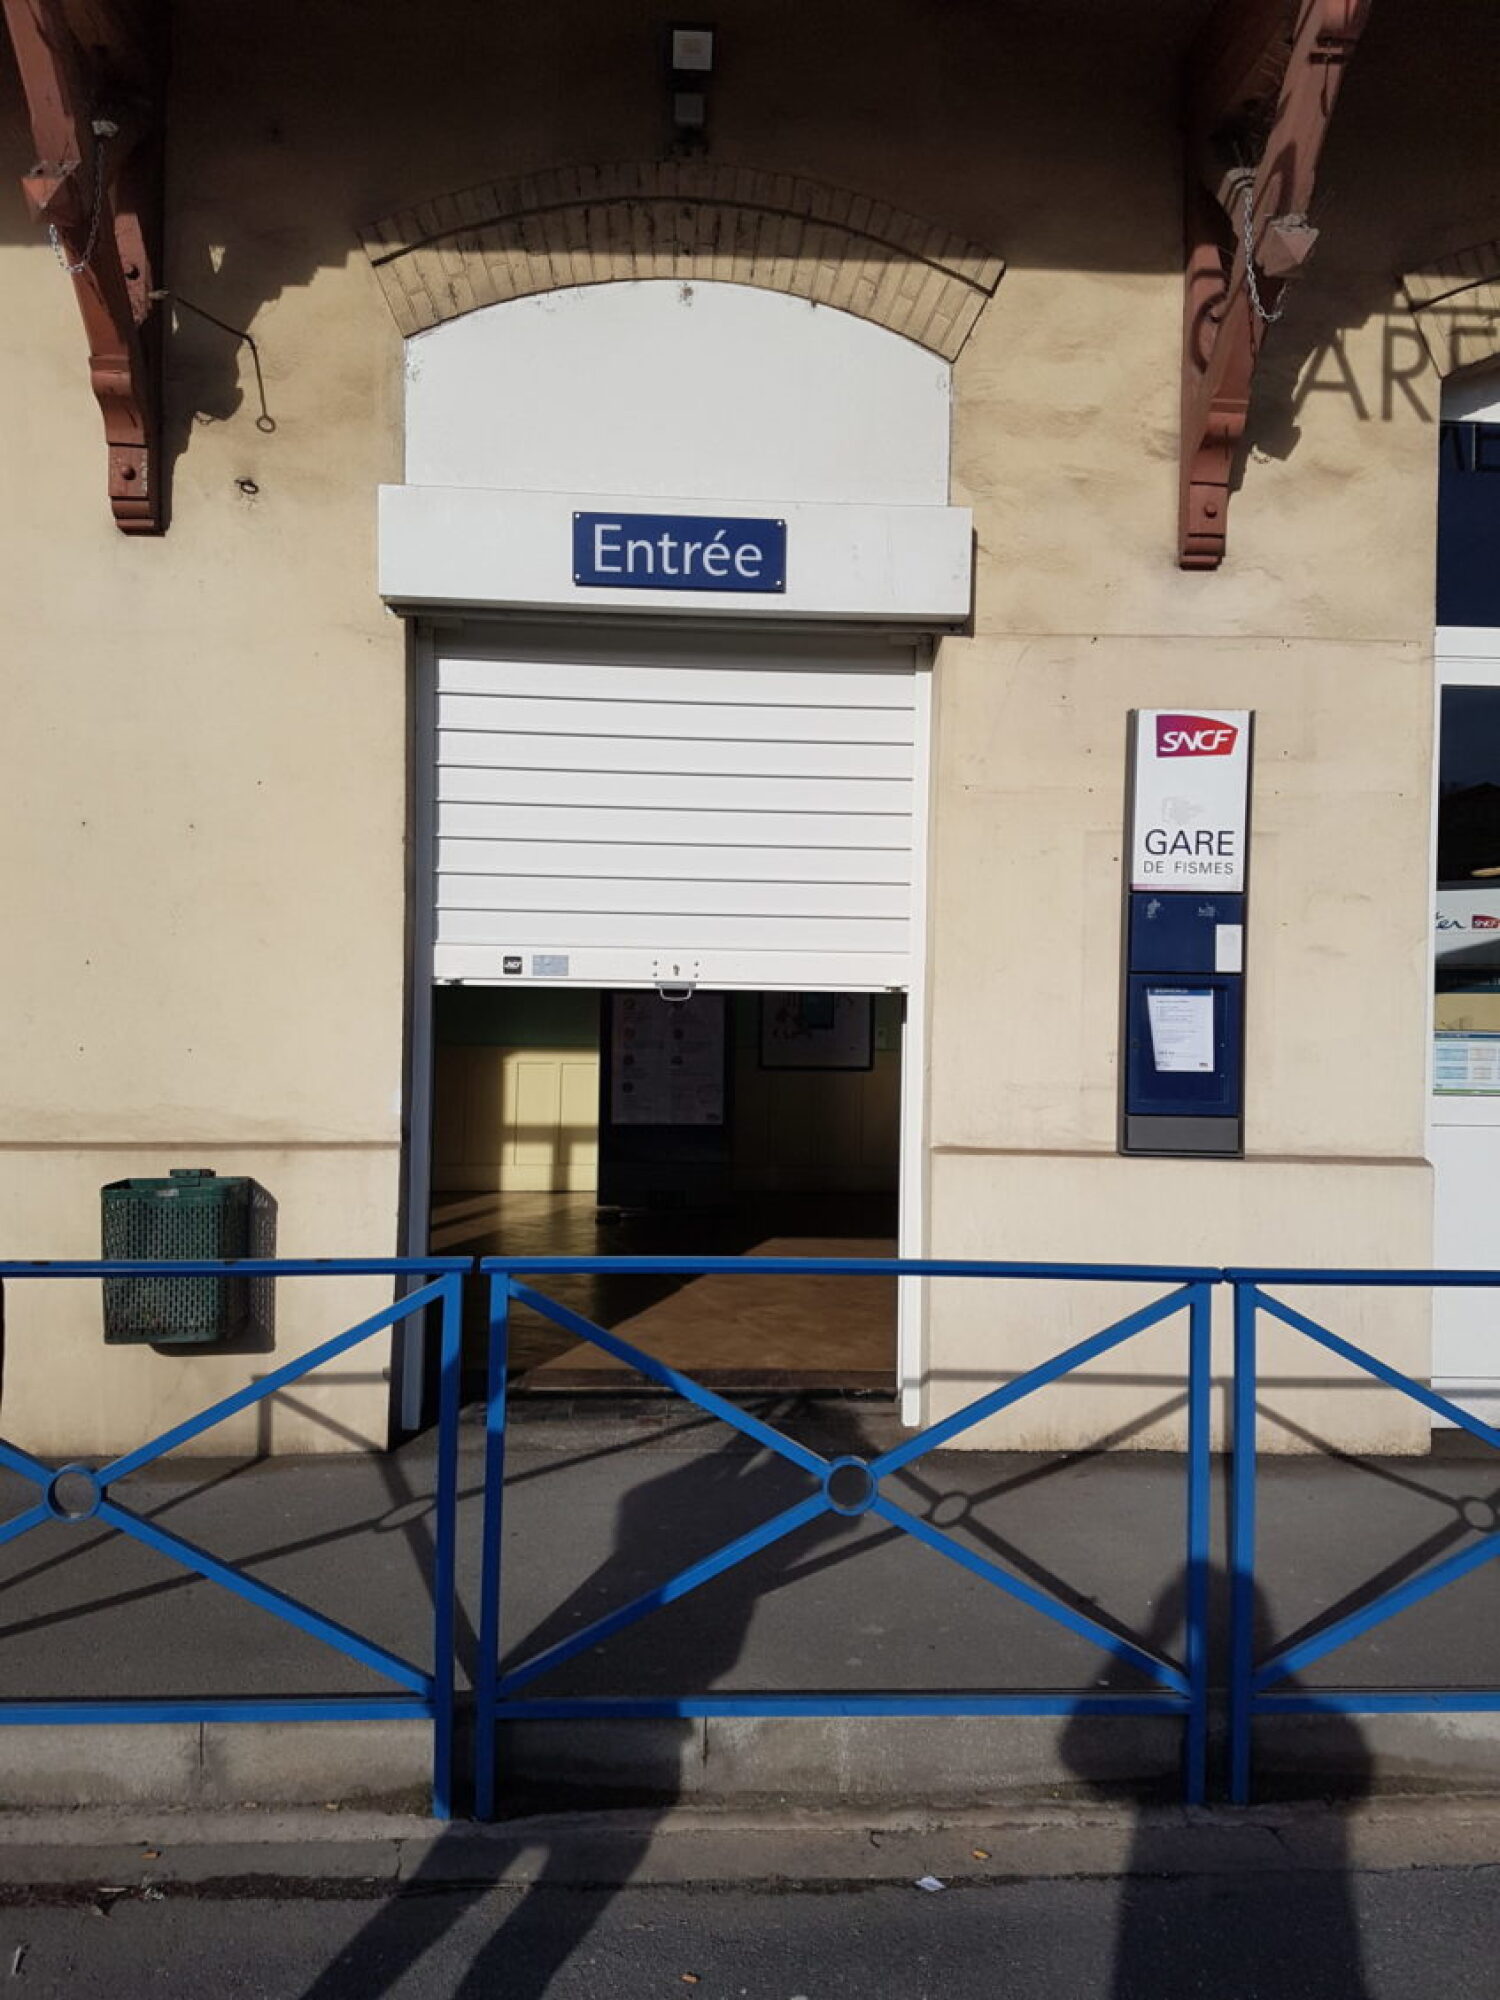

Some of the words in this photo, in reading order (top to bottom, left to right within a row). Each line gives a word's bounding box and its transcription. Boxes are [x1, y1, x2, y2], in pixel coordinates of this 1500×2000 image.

[594, 523, 763, 577] Entrée
[1159, 729, 1233, 752] SNCF
[1145, 828, 1235, 857] GARE
[1143, 861, 1165, 874] DE
[1174, 862, 1234, 875] FISMES
